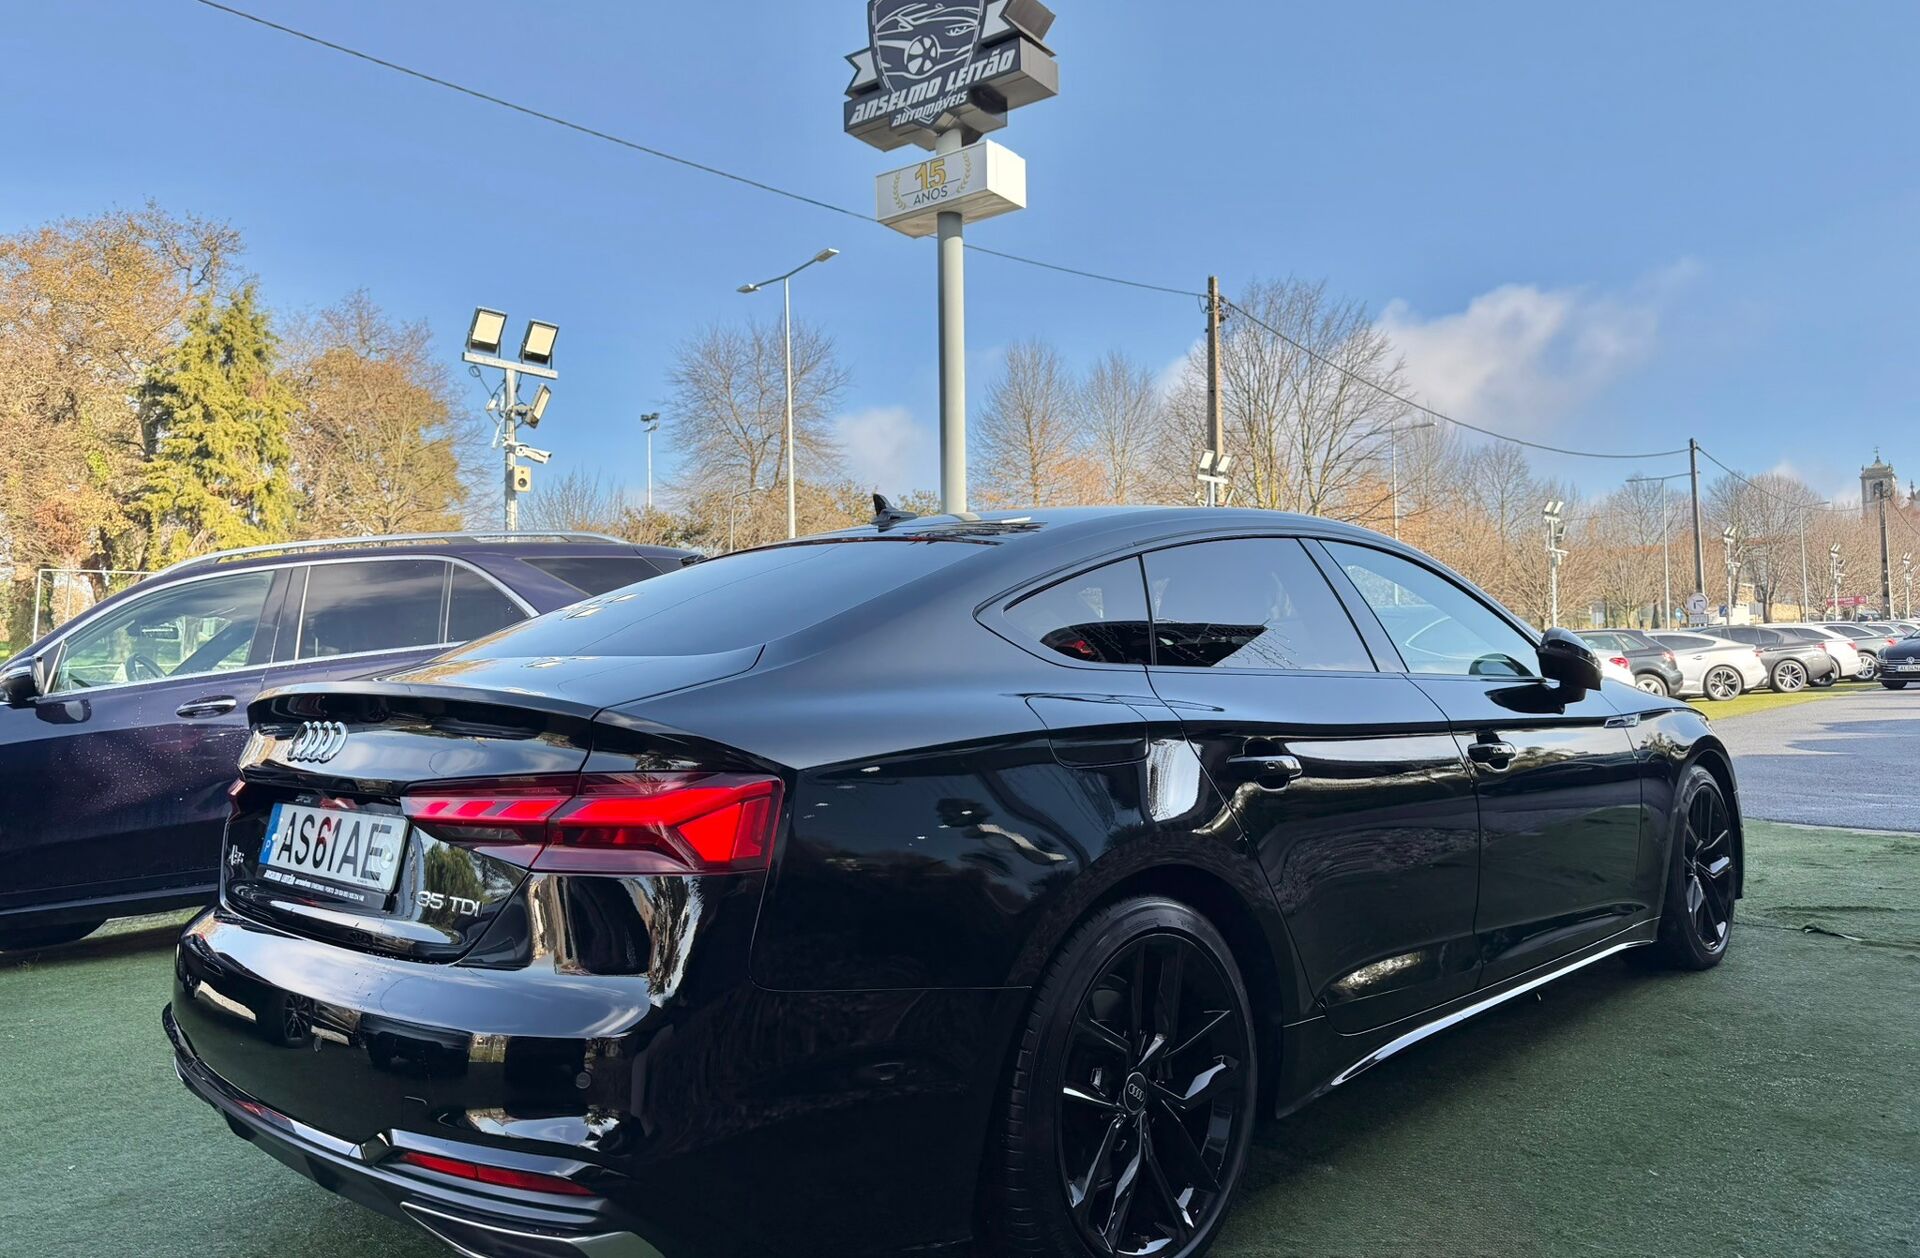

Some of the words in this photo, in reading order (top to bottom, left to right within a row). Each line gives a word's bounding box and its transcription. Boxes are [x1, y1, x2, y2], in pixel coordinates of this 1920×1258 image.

[944, 48, 1016, 92] LEITÃO
[914, 158, 947, 191] 15
[913, 185, 949, 206] ANOS
[416, 890, 445, 910] 35
[449, 895, 481, 918] TDI
